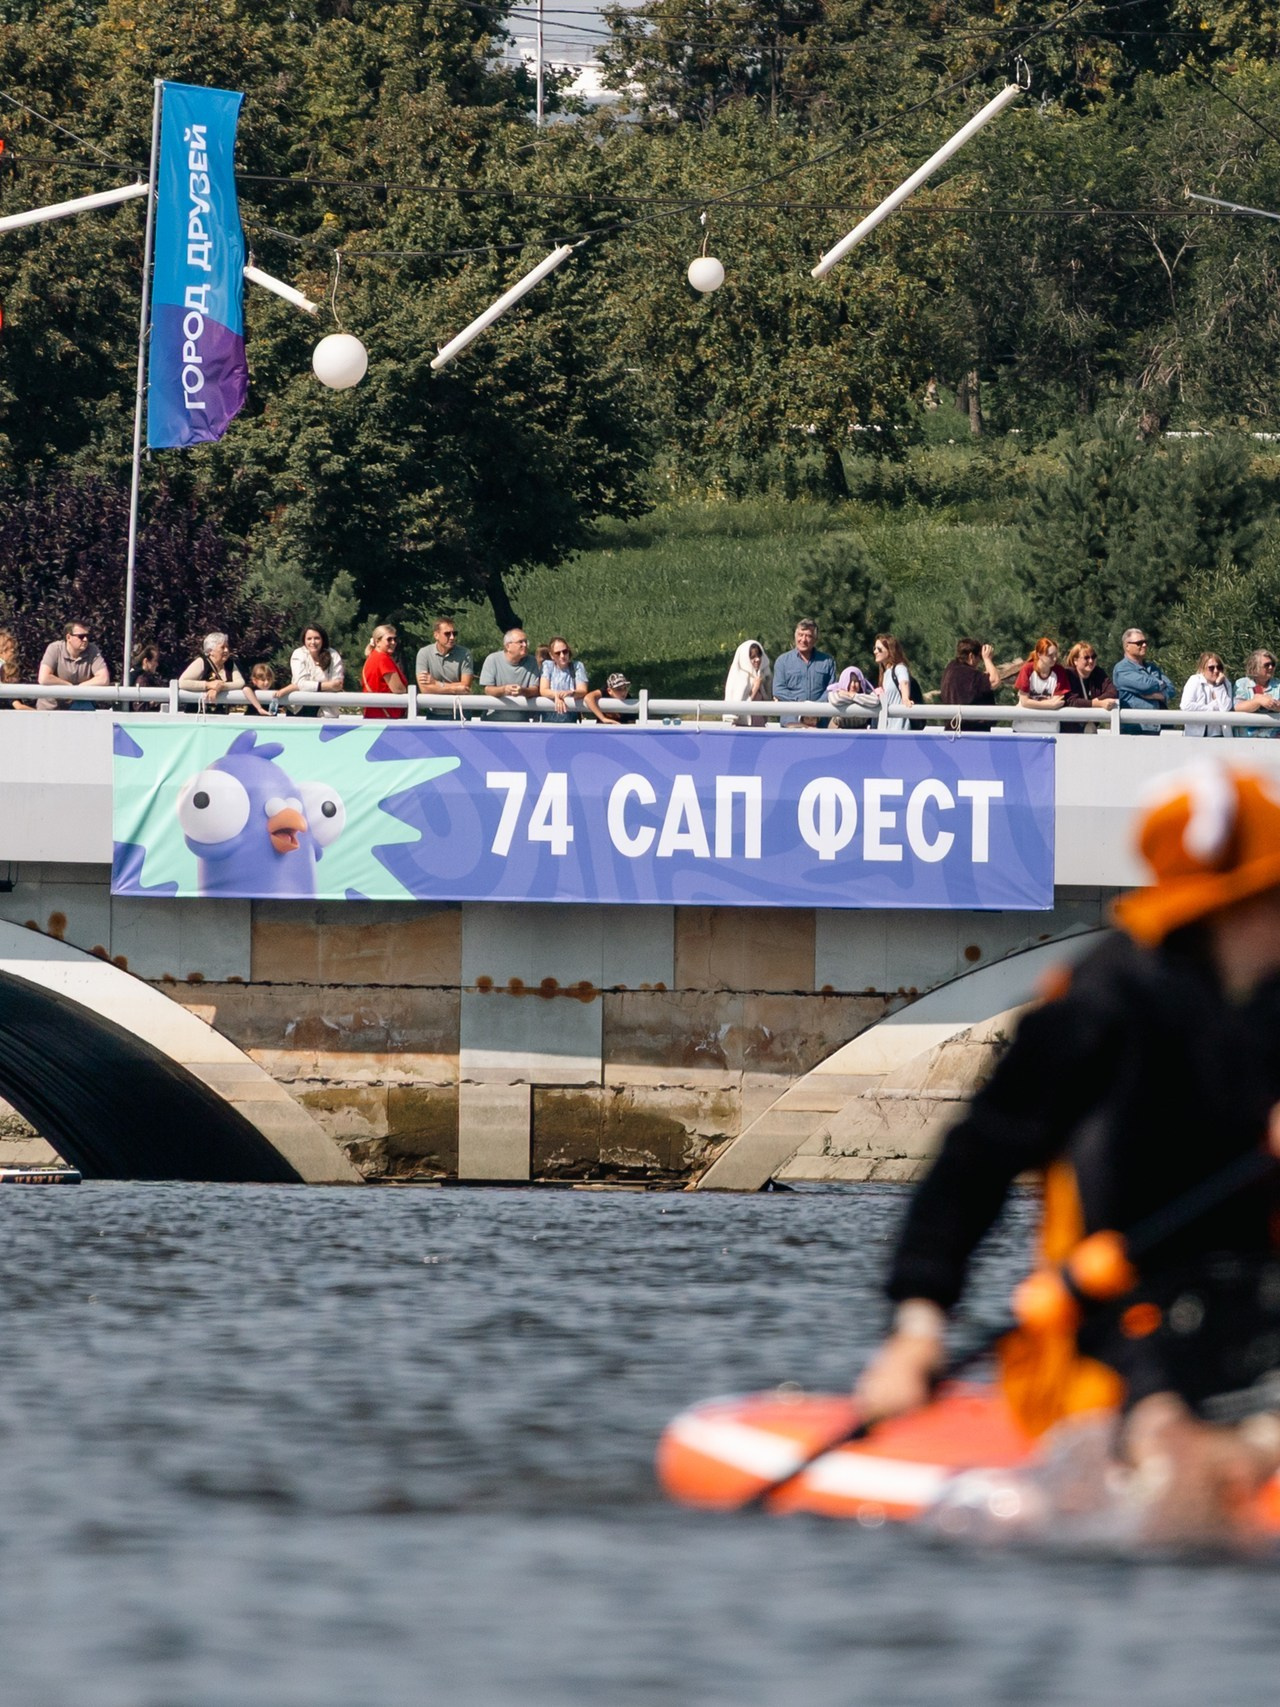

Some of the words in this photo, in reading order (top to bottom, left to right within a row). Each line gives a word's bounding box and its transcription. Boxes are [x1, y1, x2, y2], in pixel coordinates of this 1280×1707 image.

[183, 125, 213, 271] ДРУЗЕЙ
[181, 284, 211, 410] ГОРОД
[486, 771, 574, 857] 74
[606, 772, 762, 859] САП
[798, 776, 1004, 864] ФЕСТ
